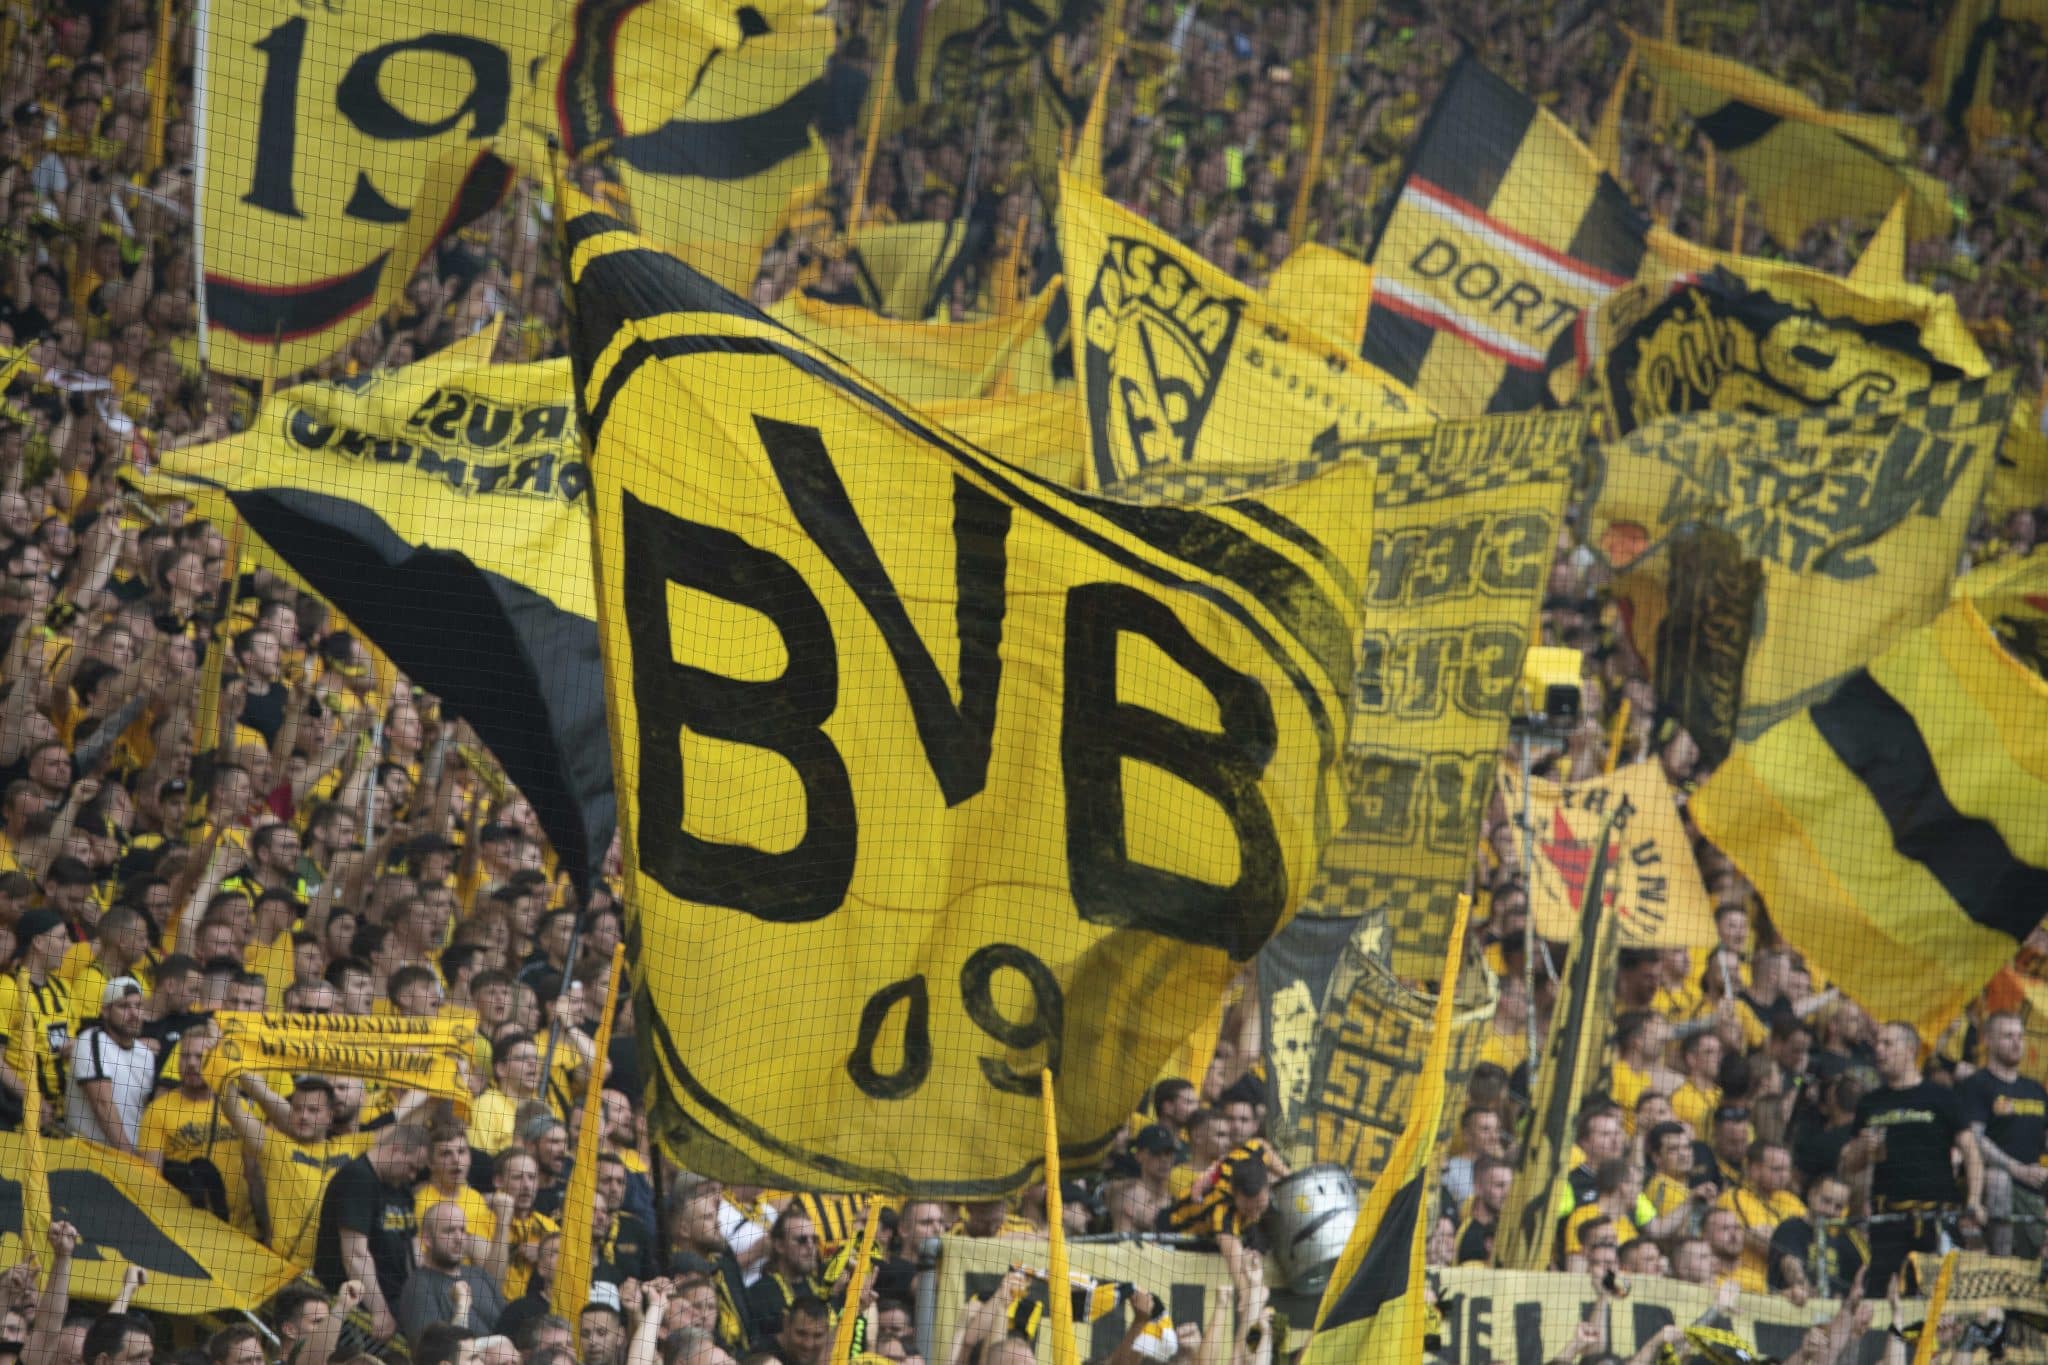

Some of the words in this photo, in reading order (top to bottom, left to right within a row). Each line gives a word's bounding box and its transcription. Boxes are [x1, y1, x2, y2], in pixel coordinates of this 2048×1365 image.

[240, 14, 512, 224] 19
[1409, 237, 1580, 333] DORT
[622, 412, 1288, 962] BVB
[847, 942, 1064, 1100] 09
